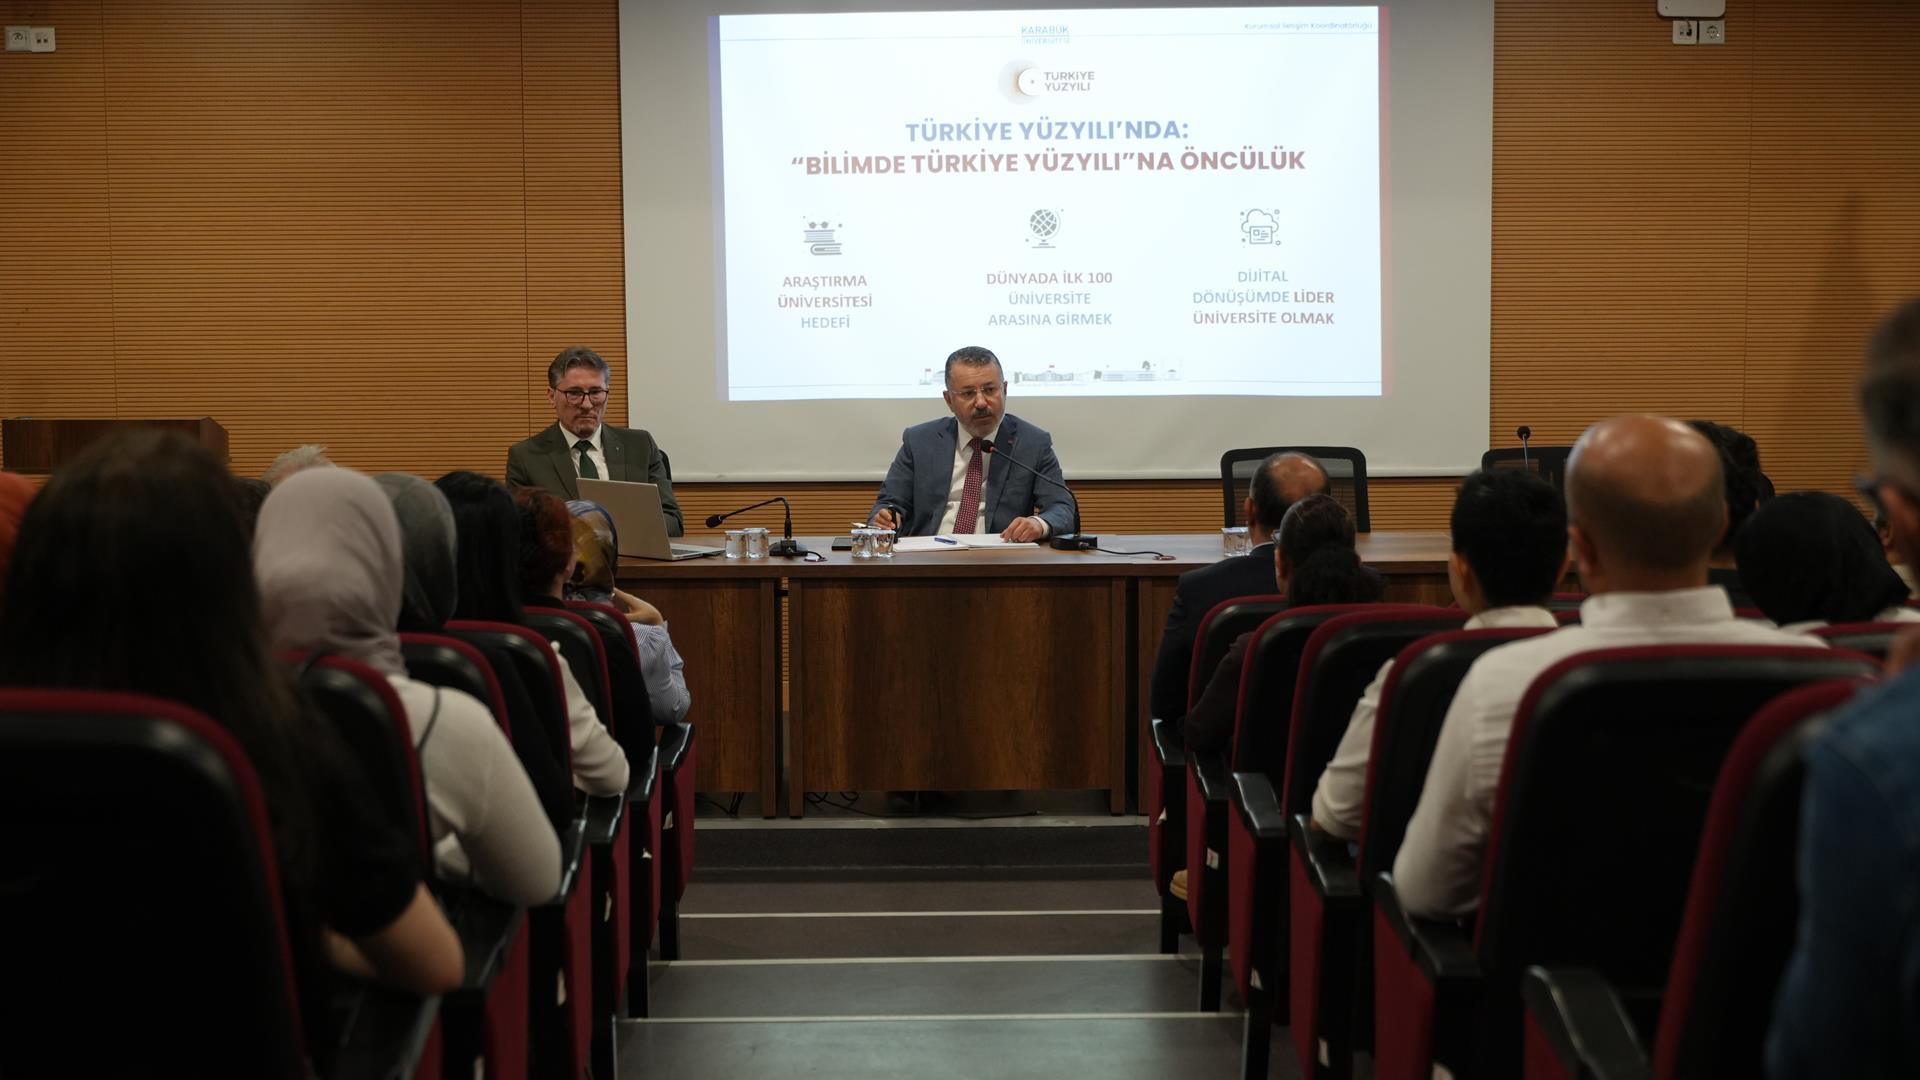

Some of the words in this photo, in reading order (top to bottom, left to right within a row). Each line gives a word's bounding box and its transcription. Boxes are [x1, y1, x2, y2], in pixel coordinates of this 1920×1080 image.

[905, 117, 1012, 142] TÜRKİYE
[1019, 116, 1189, 141] YÜZYILI’NDA:
[791, 150, 905, 175] “BİLİMDE
[911, 148, 1018, 173] TÜRKİYE
[1180, 145, 1306, 170] ÖNCÜLÜK
[986, 270, 1058, 285] DÜNYADA
[1062, 270, 1084, 284] İLK
[1088, 272, 1113, 284] 100
[1238, 268, 1288, 282] DİJİTAL
[782, 275, 867, 291] ARAŞTIRMA
[777, 293, 873, 308] ÜNİVERSİTESİ
[1009, 291, 1091, 305] ÜNİVERSİTE
[1193, 289, 1290, 306] DÖNÜŞÜMDE
[1294, 289, 1335, 304] LİDER
[801, 314, 851, 329] HEDEFİ
[988, 314, 1052, 326] ARASINA
[1055, 312, 1112, 326] GİRMEK
[1193, 310, 1277, 325] ÜNİVERSİTE
[1281, 311, 1335, 325] OLMAK
